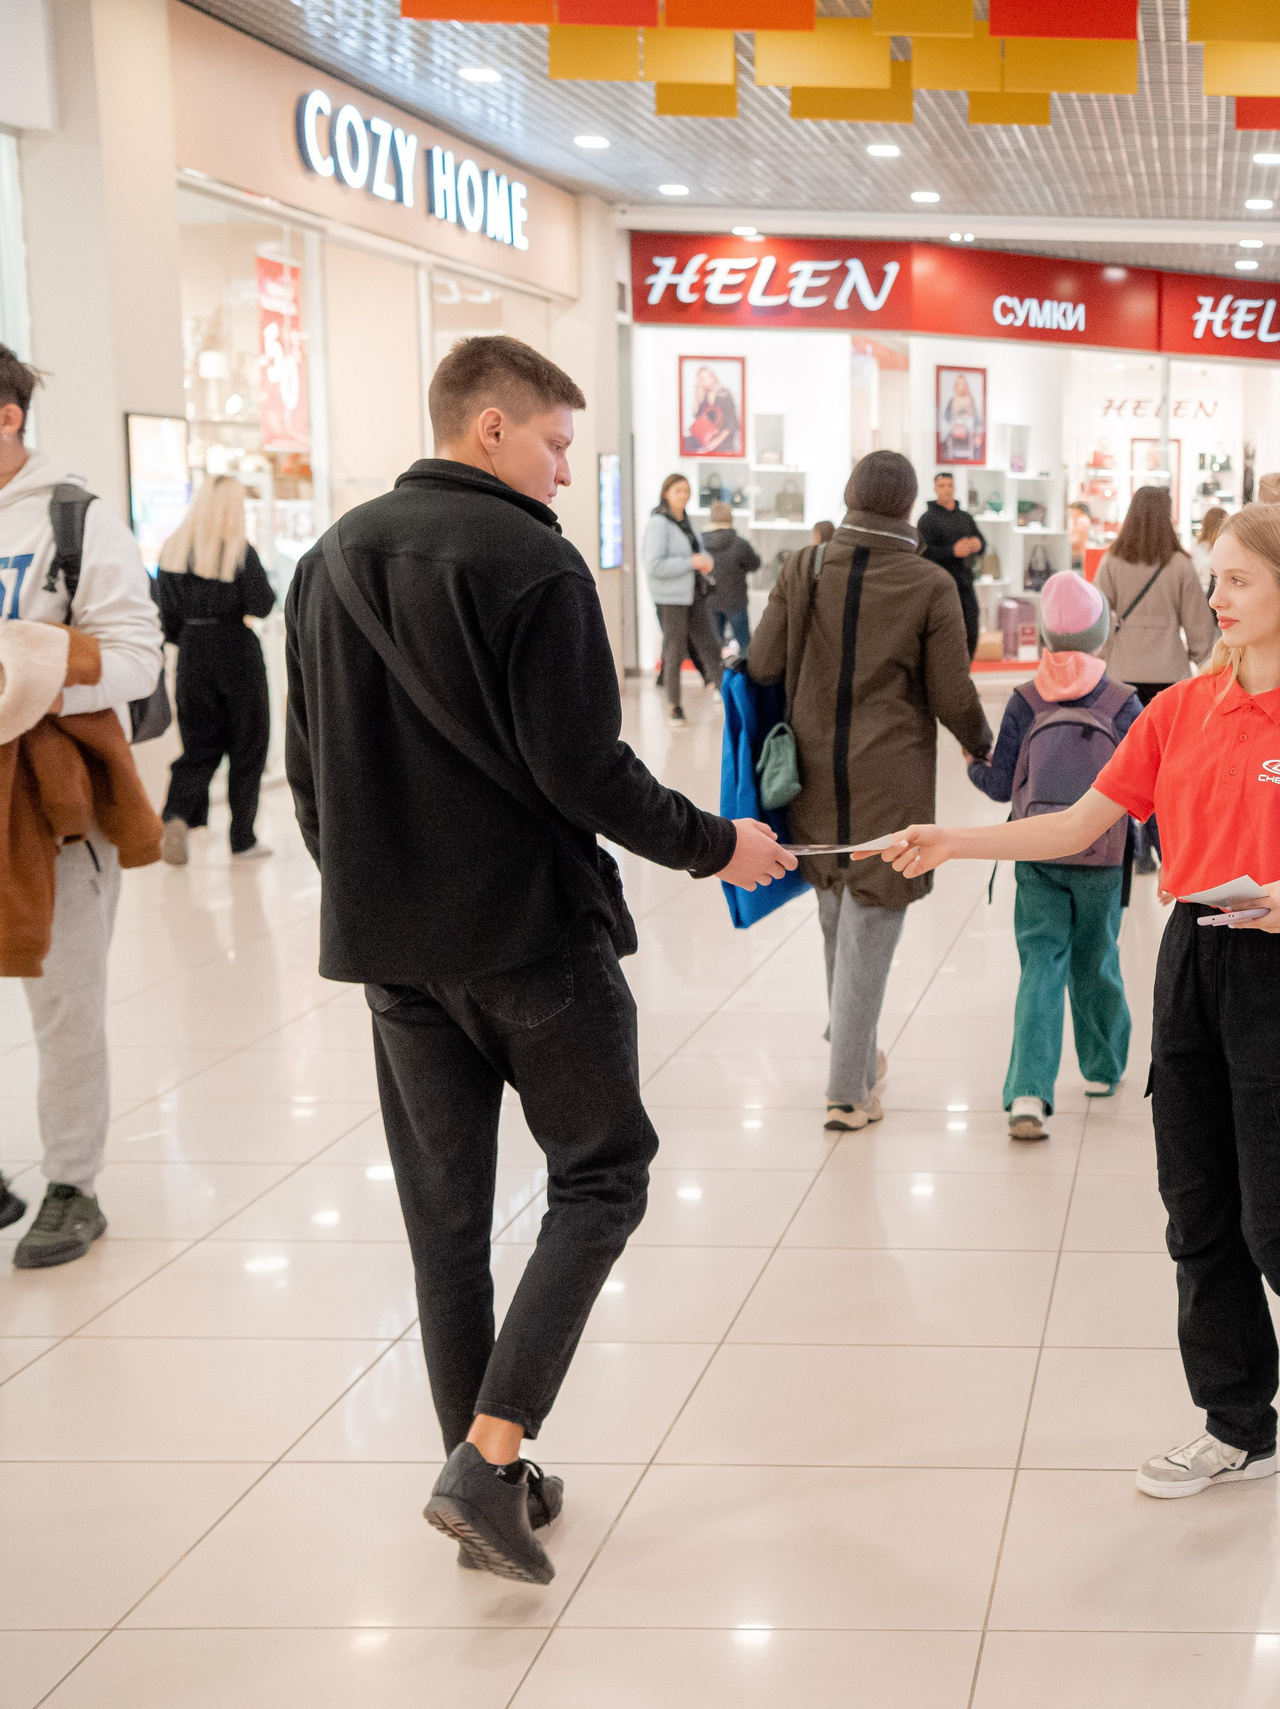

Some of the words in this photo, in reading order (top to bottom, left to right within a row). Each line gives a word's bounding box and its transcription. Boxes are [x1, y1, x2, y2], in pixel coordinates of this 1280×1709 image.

[302, 89, 418, 208] COZY
[431, 144, 529, 251] HOME
[645, 253, 900, 312] HELEN
[992, 294, 1086, 332] СУМКИ
